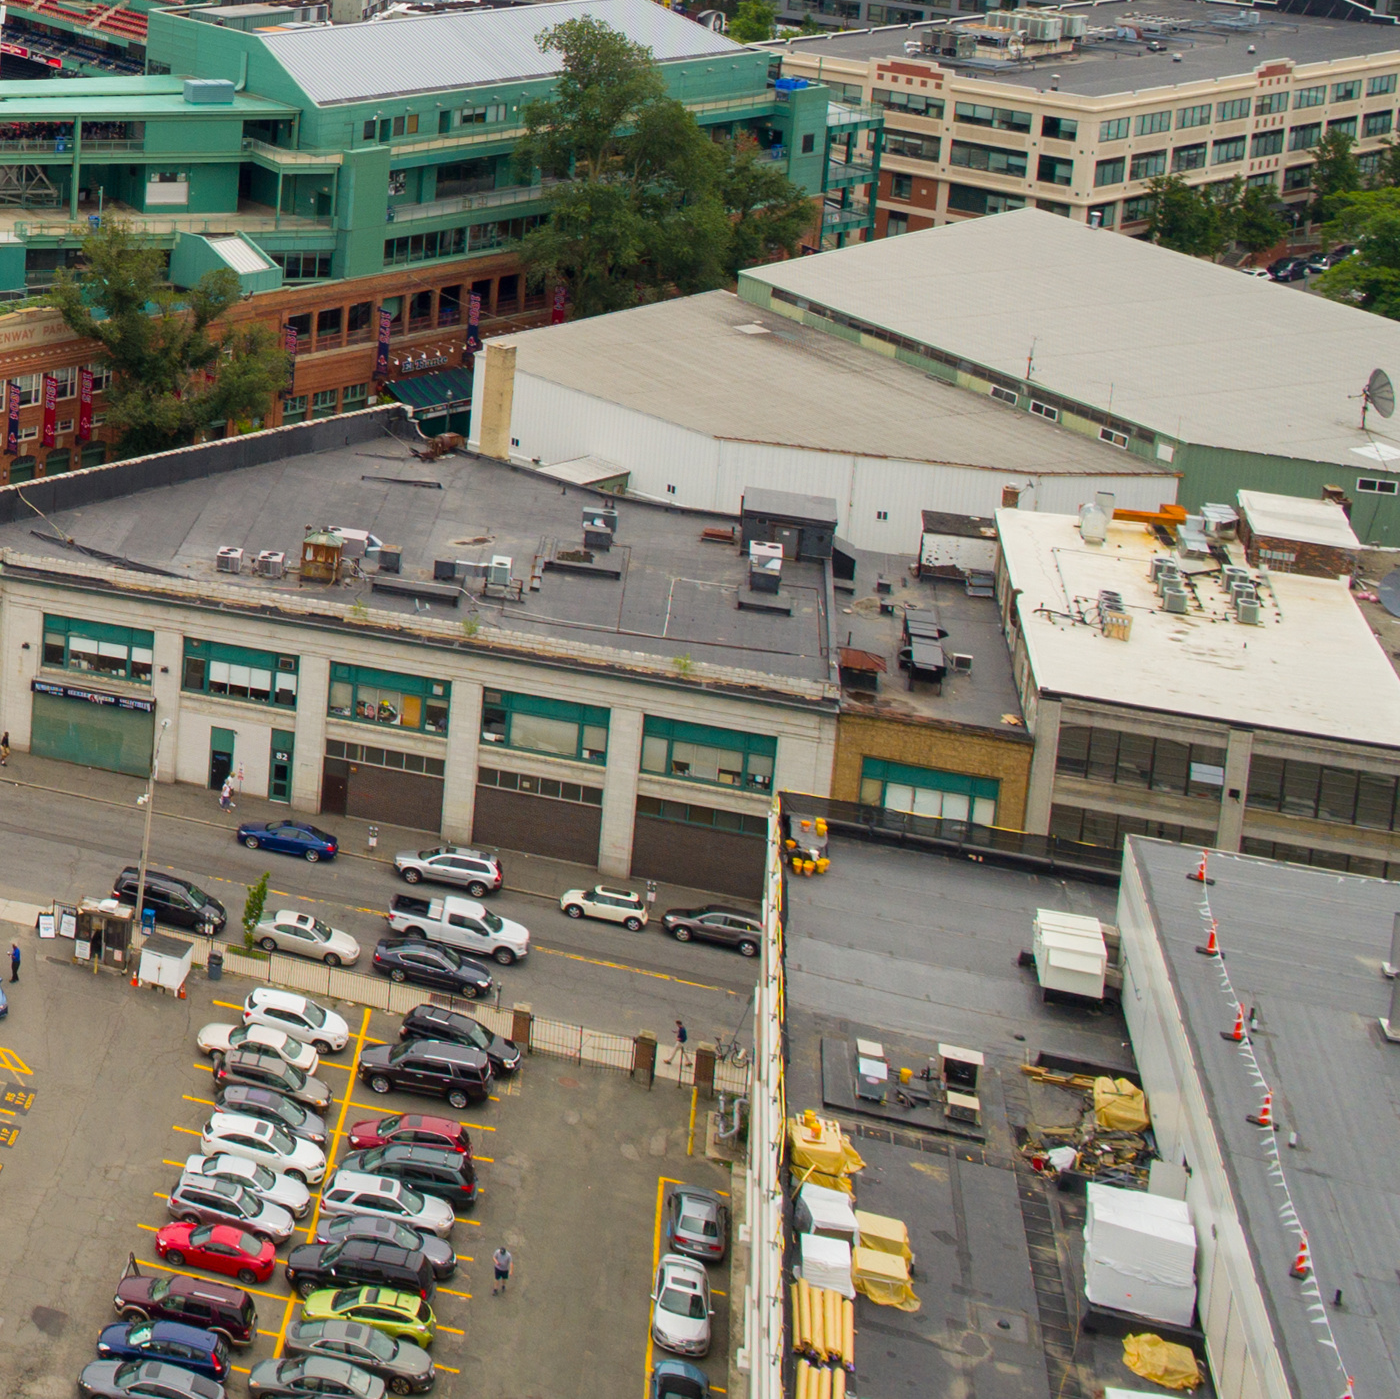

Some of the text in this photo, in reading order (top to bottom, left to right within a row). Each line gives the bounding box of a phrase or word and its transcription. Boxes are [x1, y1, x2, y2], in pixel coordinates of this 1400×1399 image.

[43, 320, 70, 336] PARK
[401, 361, 414, 372] El
[45, 379, 57, 411] 1912
[81, 372, 93, 404] 1915
[9, 385, 21, 420] 1904
[275, 752, 288, 761] 82
